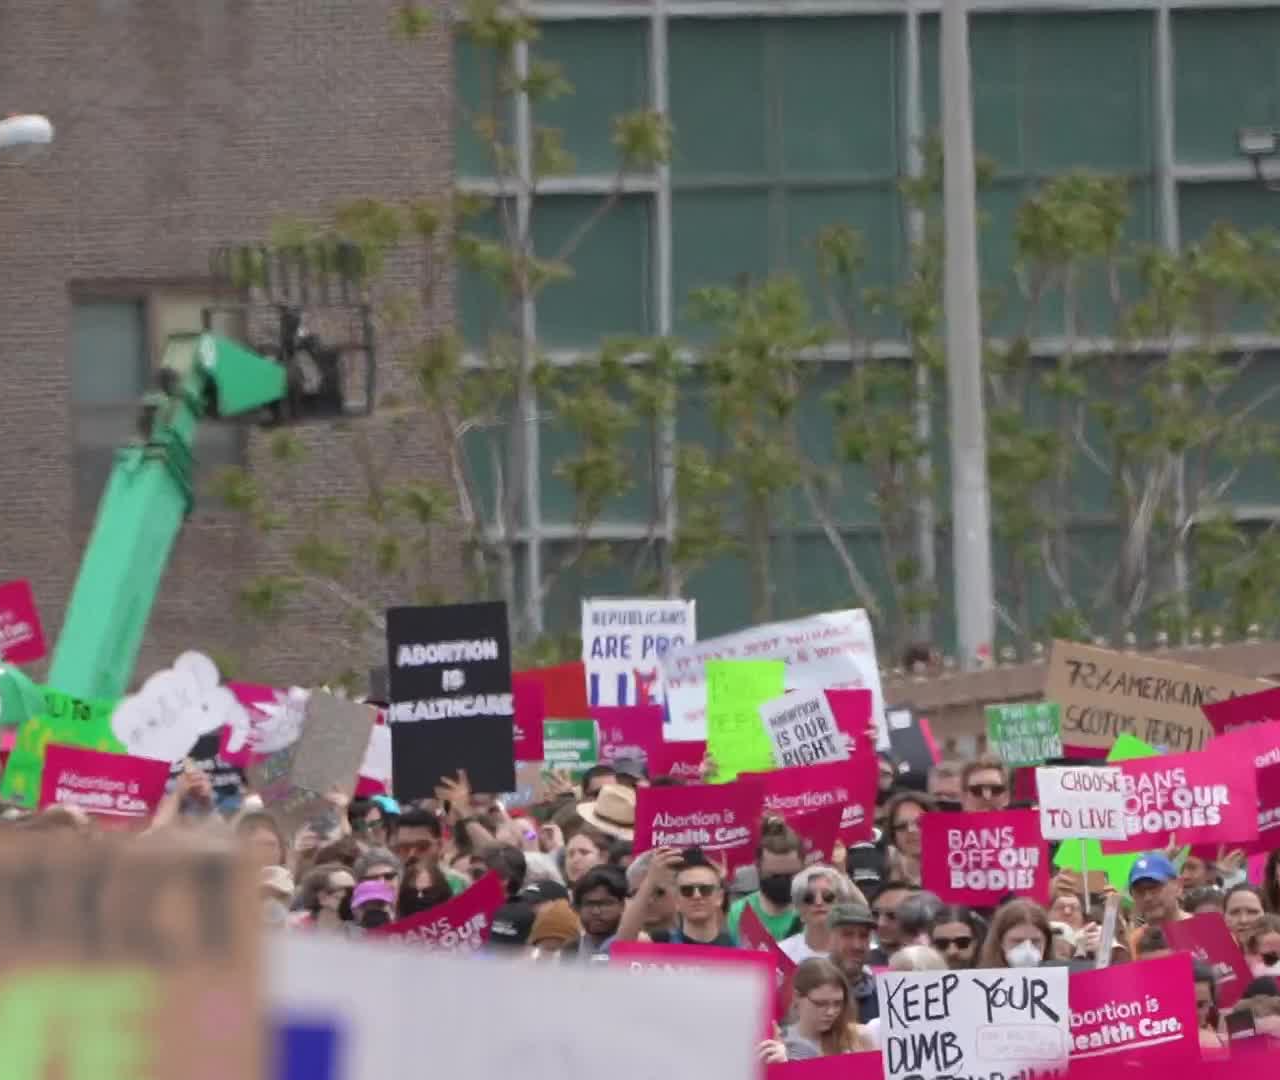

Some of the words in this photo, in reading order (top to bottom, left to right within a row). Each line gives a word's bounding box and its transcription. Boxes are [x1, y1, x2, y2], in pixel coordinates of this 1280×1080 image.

[396, 637, 498, 667] ABORTION
[591, 633, 632, 659] ARE
[441, 668, 466, 693] IS
[389, 693, 515, 723] HEALTHCARE
[793, 715, 828, 742] OUR
[782, 733, 837, 768] RIGHT
[1122, 768, 1187, 794] BANS
[1124, 789, 1169, 815] OFF
[1172, 784, 1230, 811] OUR
[652, 811, 721, 828] Abortion
[1047, 809, 1072, 830] TO
[1079, 808, 1116, 830] LIVE
[1127, 804, 1222, 836] BODIES
[947, 826, 1015, 849] BANS
[947, 848, 996, 870] OFF
[884, 973, 959, 1029] KEEP
[1070, 1000, 1141, 1027] bortion
[1145, 994, 1159, 1013] is
[1071, 1021, 1135, 1050] ealth
[887, 1031, 963, 1074] DUMB
